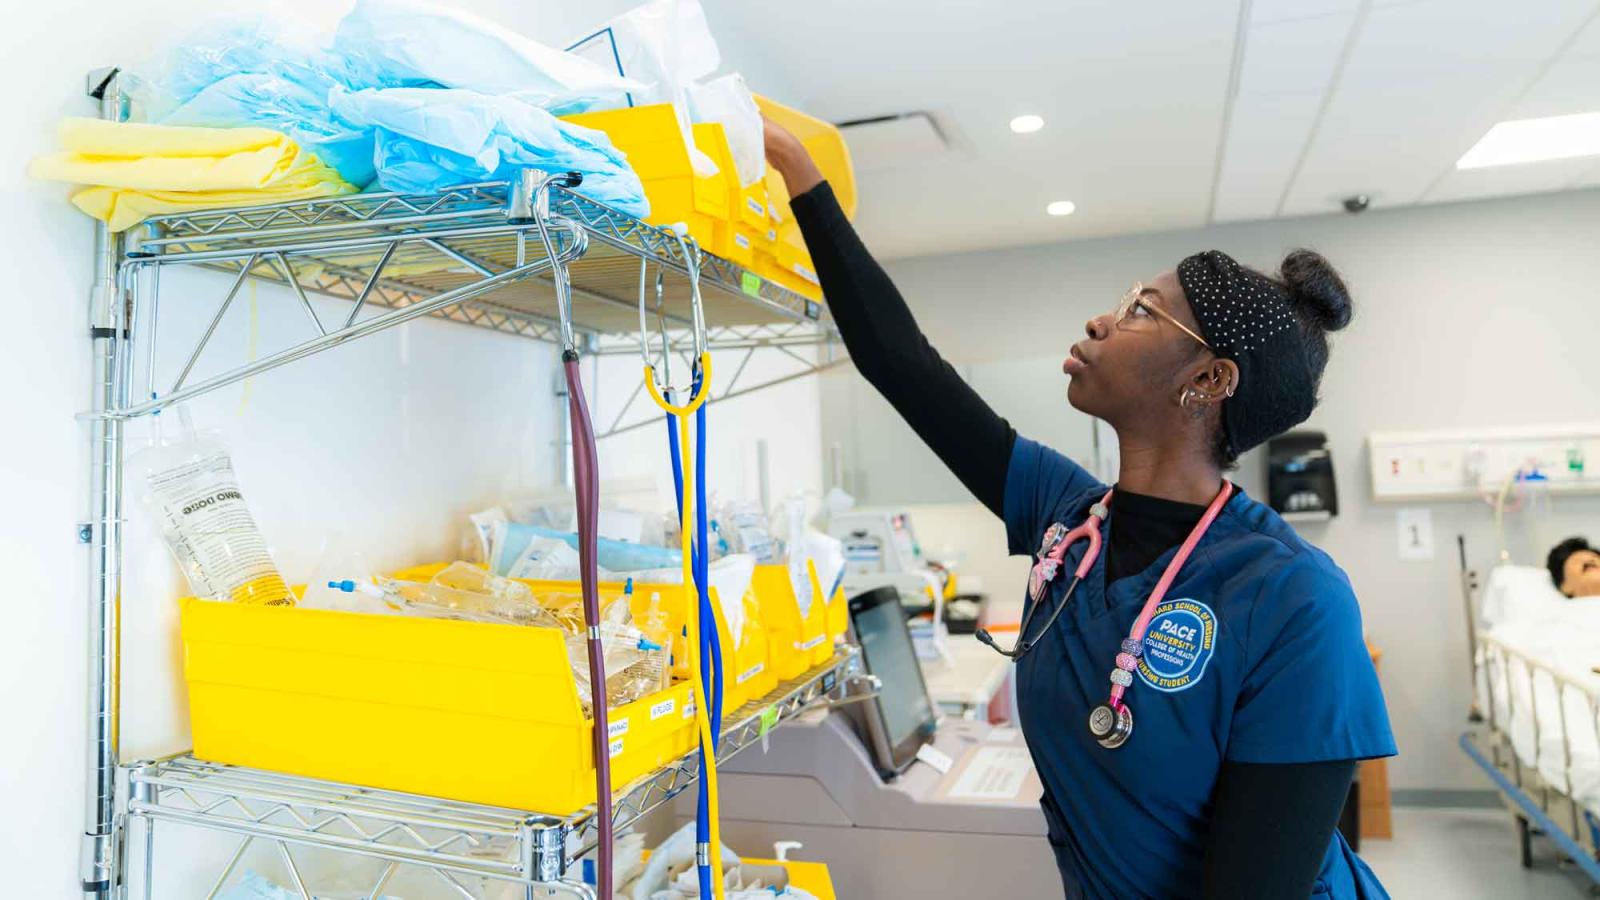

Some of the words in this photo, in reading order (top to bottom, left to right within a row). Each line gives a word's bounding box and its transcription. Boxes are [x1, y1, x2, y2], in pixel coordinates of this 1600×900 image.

[1409, 524, 1423, 547] 1
[1175, 602, 1202, 615] SCHOOL
[1200, 611, 1211, 621] OF
[1160, 619, 1197, 641] PACE
[1145, 637, 1167, 651] COLLEGE
[1168, 646, 1176, 654] OF
[1177, 649, 1195, 660] HEALTH
[1149, 631, 1195, 652] UNIVERSITY
[1150, 648, 1184, 666] PROFESSIONS
[1160, 675, 1190, 687] STUDENT
